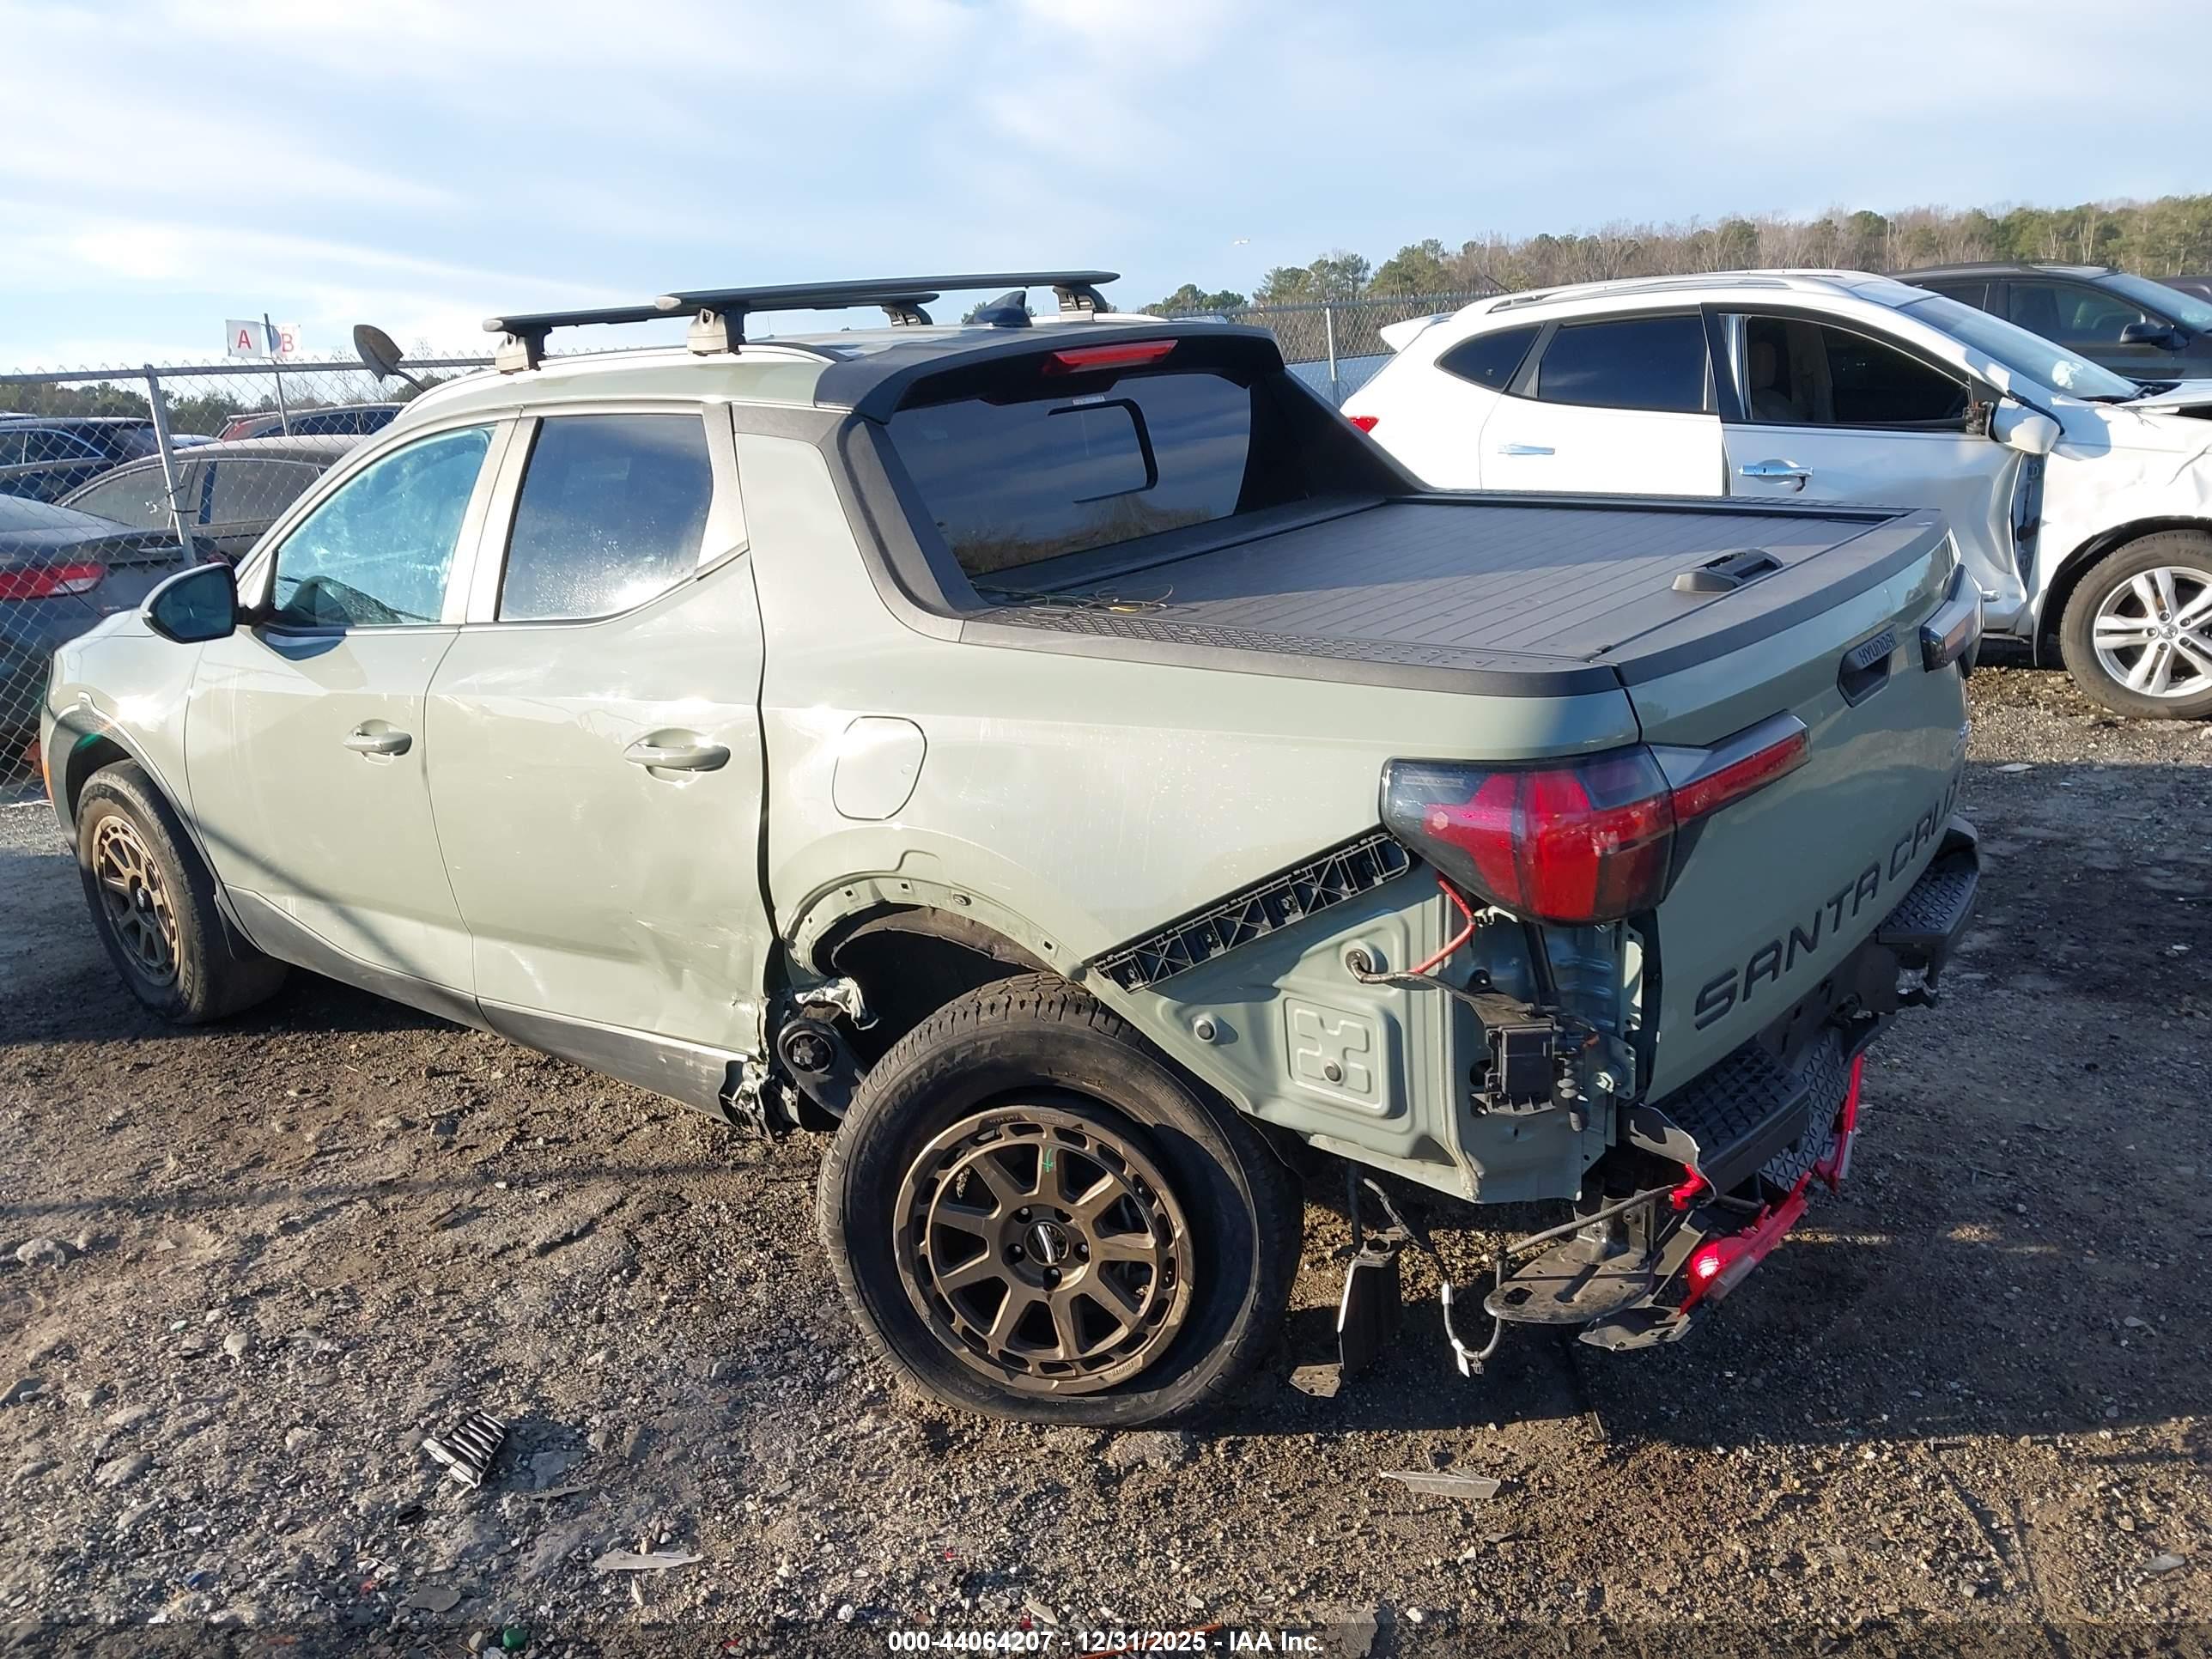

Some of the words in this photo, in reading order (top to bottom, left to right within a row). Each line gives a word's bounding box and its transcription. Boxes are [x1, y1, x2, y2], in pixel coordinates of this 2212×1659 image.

[237, 329, 252, 349] A
[282, 333, 295, 352] B
[1858, 631, 1896, 665] HYUNDAI
[1695, 861, 1881, 1030] SANTA
